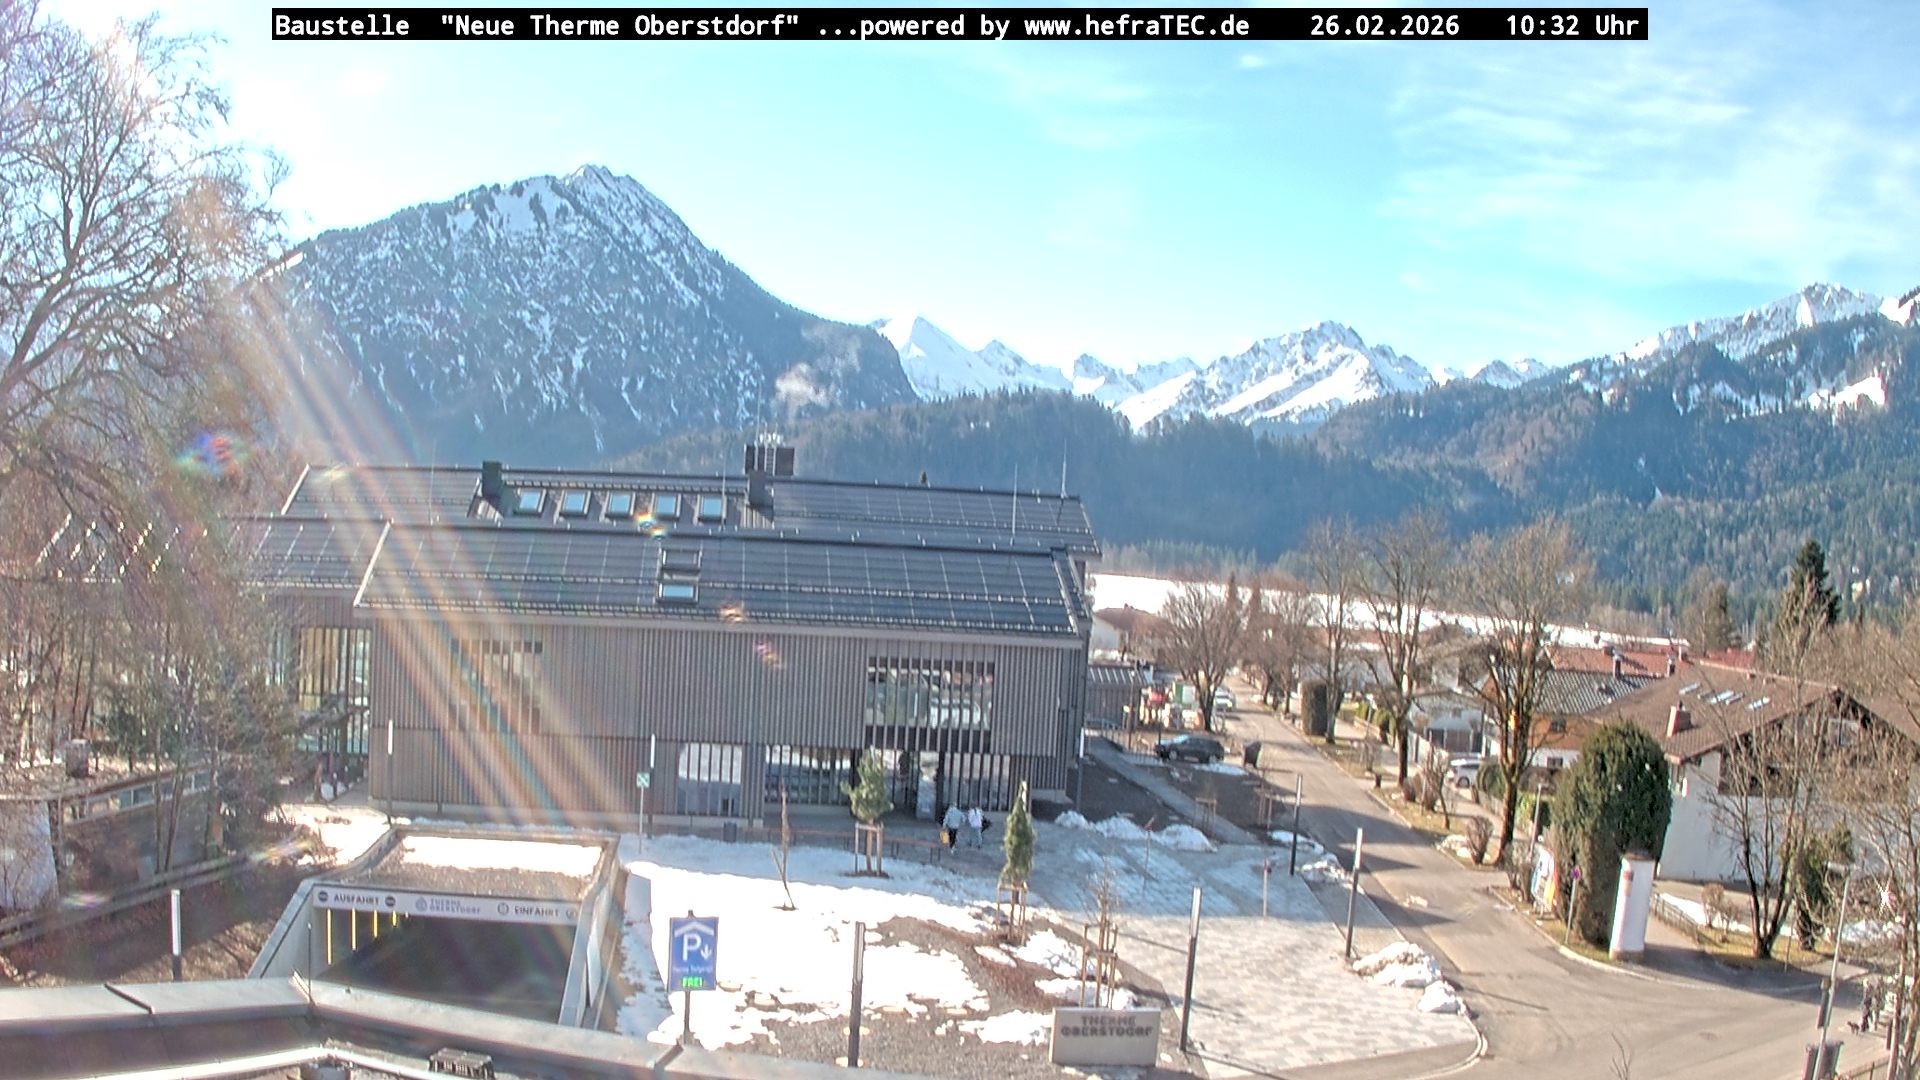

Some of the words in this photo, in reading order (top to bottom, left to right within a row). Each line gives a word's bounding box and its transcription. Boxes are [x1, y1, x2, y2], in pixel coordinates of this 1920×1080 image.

[333, 893, 380, 906] AUSFAHRT
[514, 905, 560, 917] EINFAHRT
[682, 933, 702, 962] P
[1081, 1015, 1137, 1026] THERME
[1061, 1025, 1153, 1037] OBERSTDORF
